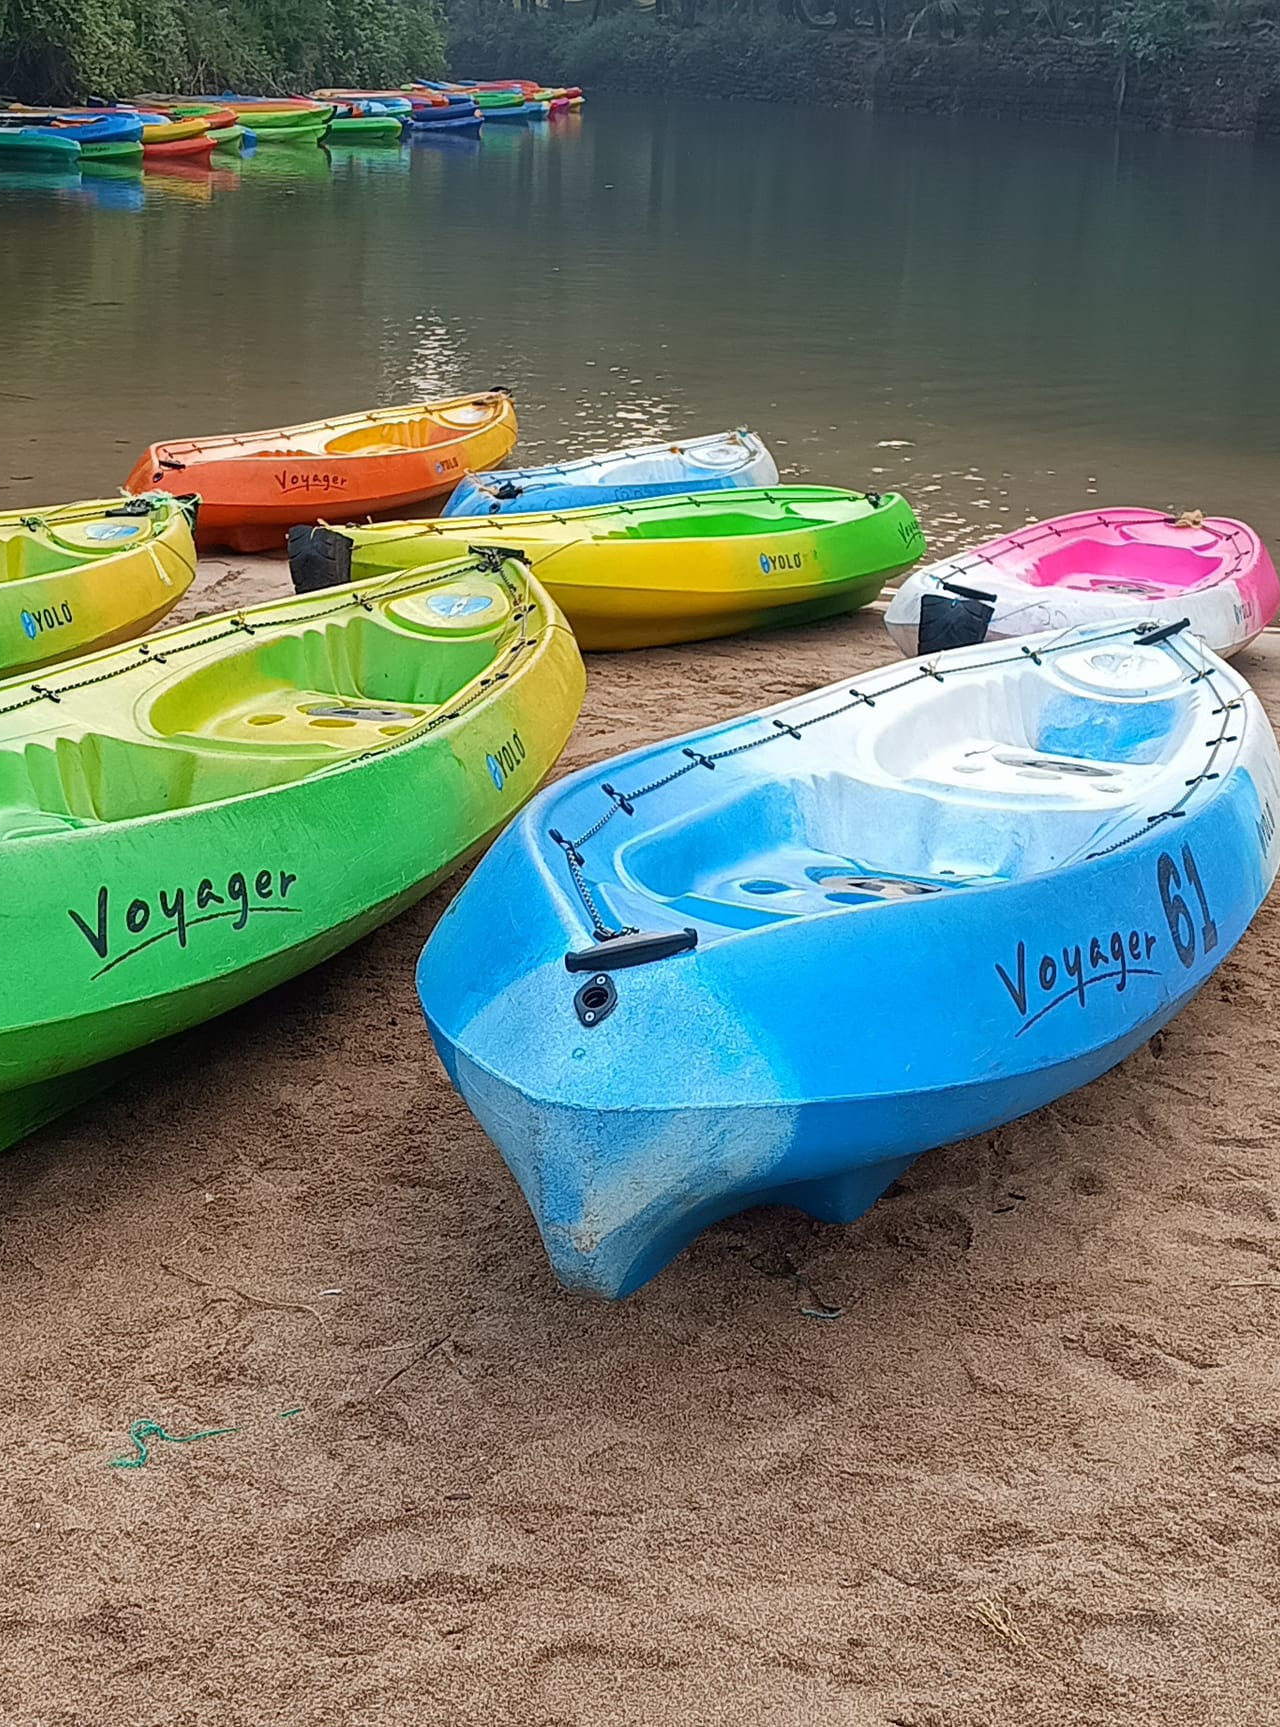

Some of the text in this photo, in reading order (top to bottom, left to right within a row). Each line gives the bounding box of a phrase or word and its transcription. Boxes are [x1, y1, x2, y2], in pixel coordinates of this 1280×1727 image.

[274, 470, 348, 491] Voyager
[769, 552, 802, 570] YOLO
[31, 603, 73, 632] YOLO
[494, 733, 526, 779] YOLO
[67, 869, 297, 958] Voyager
[1157, 840, 1218, 968] 61
[995, 930, 1156, 1016] Voyager
